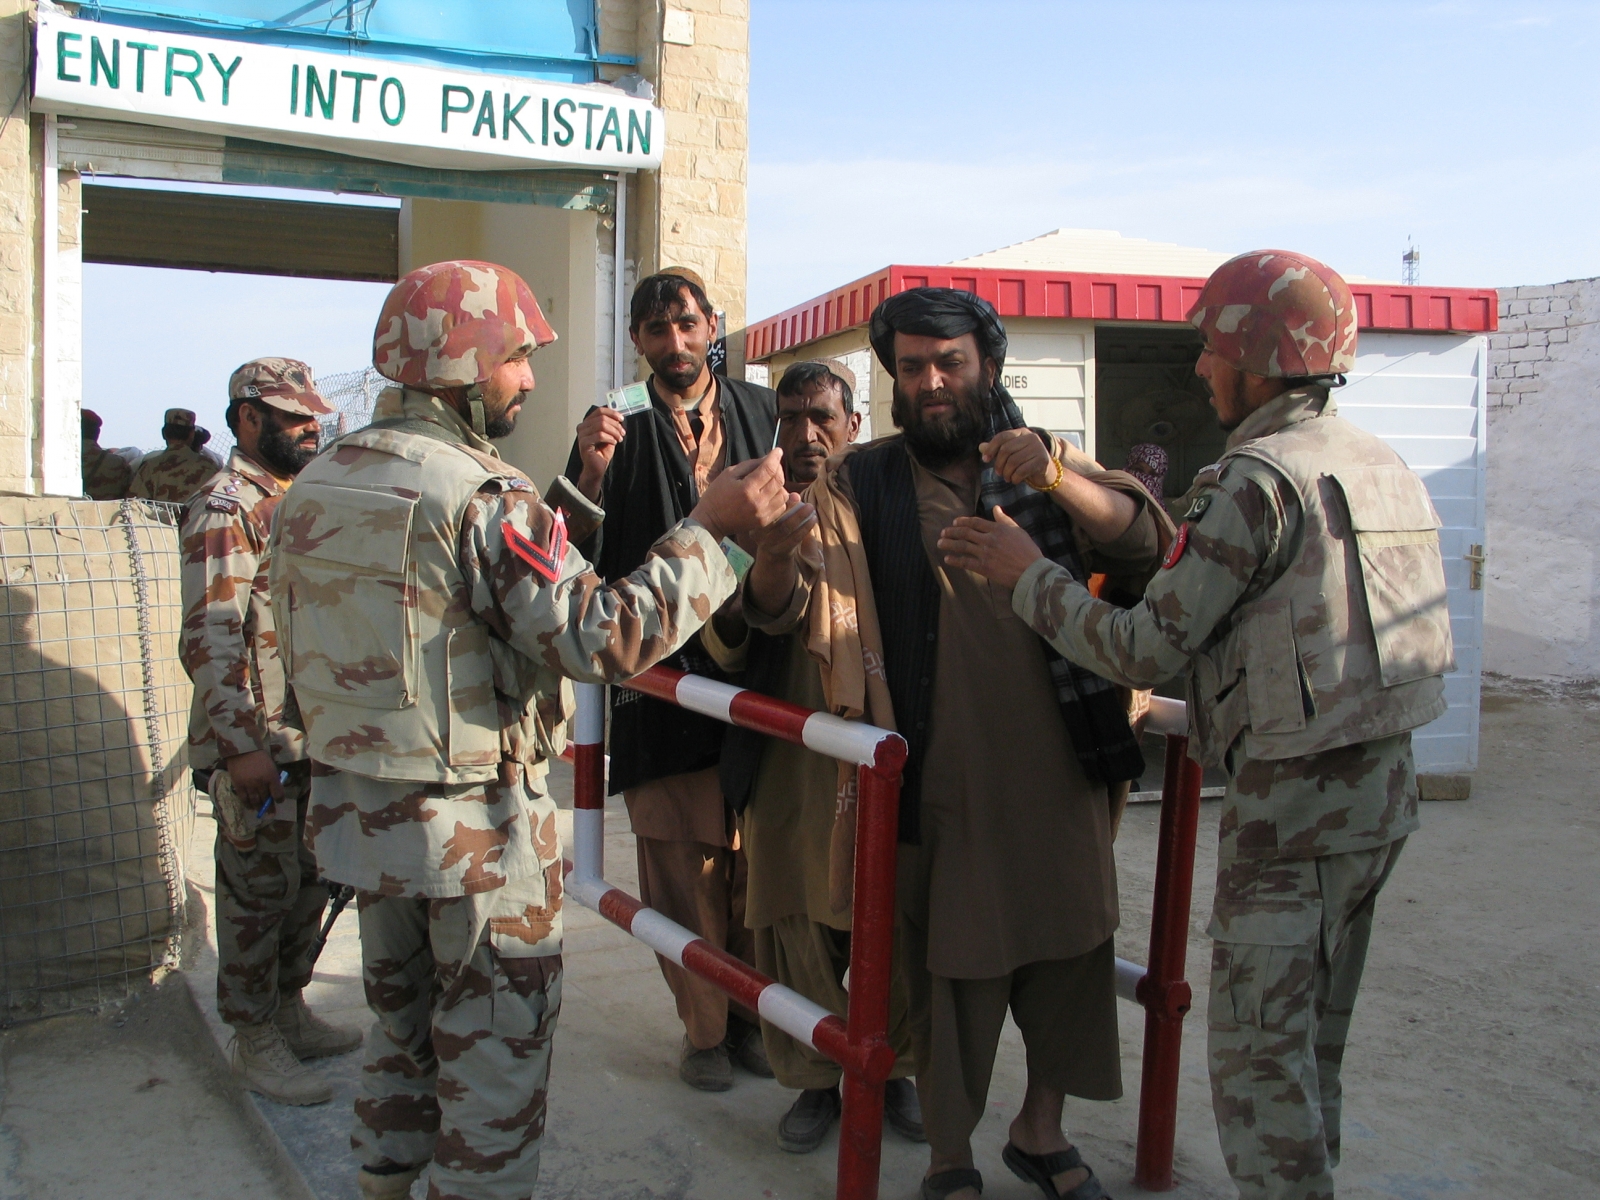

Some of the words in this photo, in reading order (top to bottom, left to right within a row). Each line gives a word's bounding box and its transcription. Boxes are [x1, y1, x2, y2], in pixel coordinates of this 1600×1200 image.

[57, 31, 243, 106] ENTRY
[290, 64, 406, 127] INTO
[441, 84, 653, 155] PAKISTAN
[1004, 375, 1028, 389] DIES
